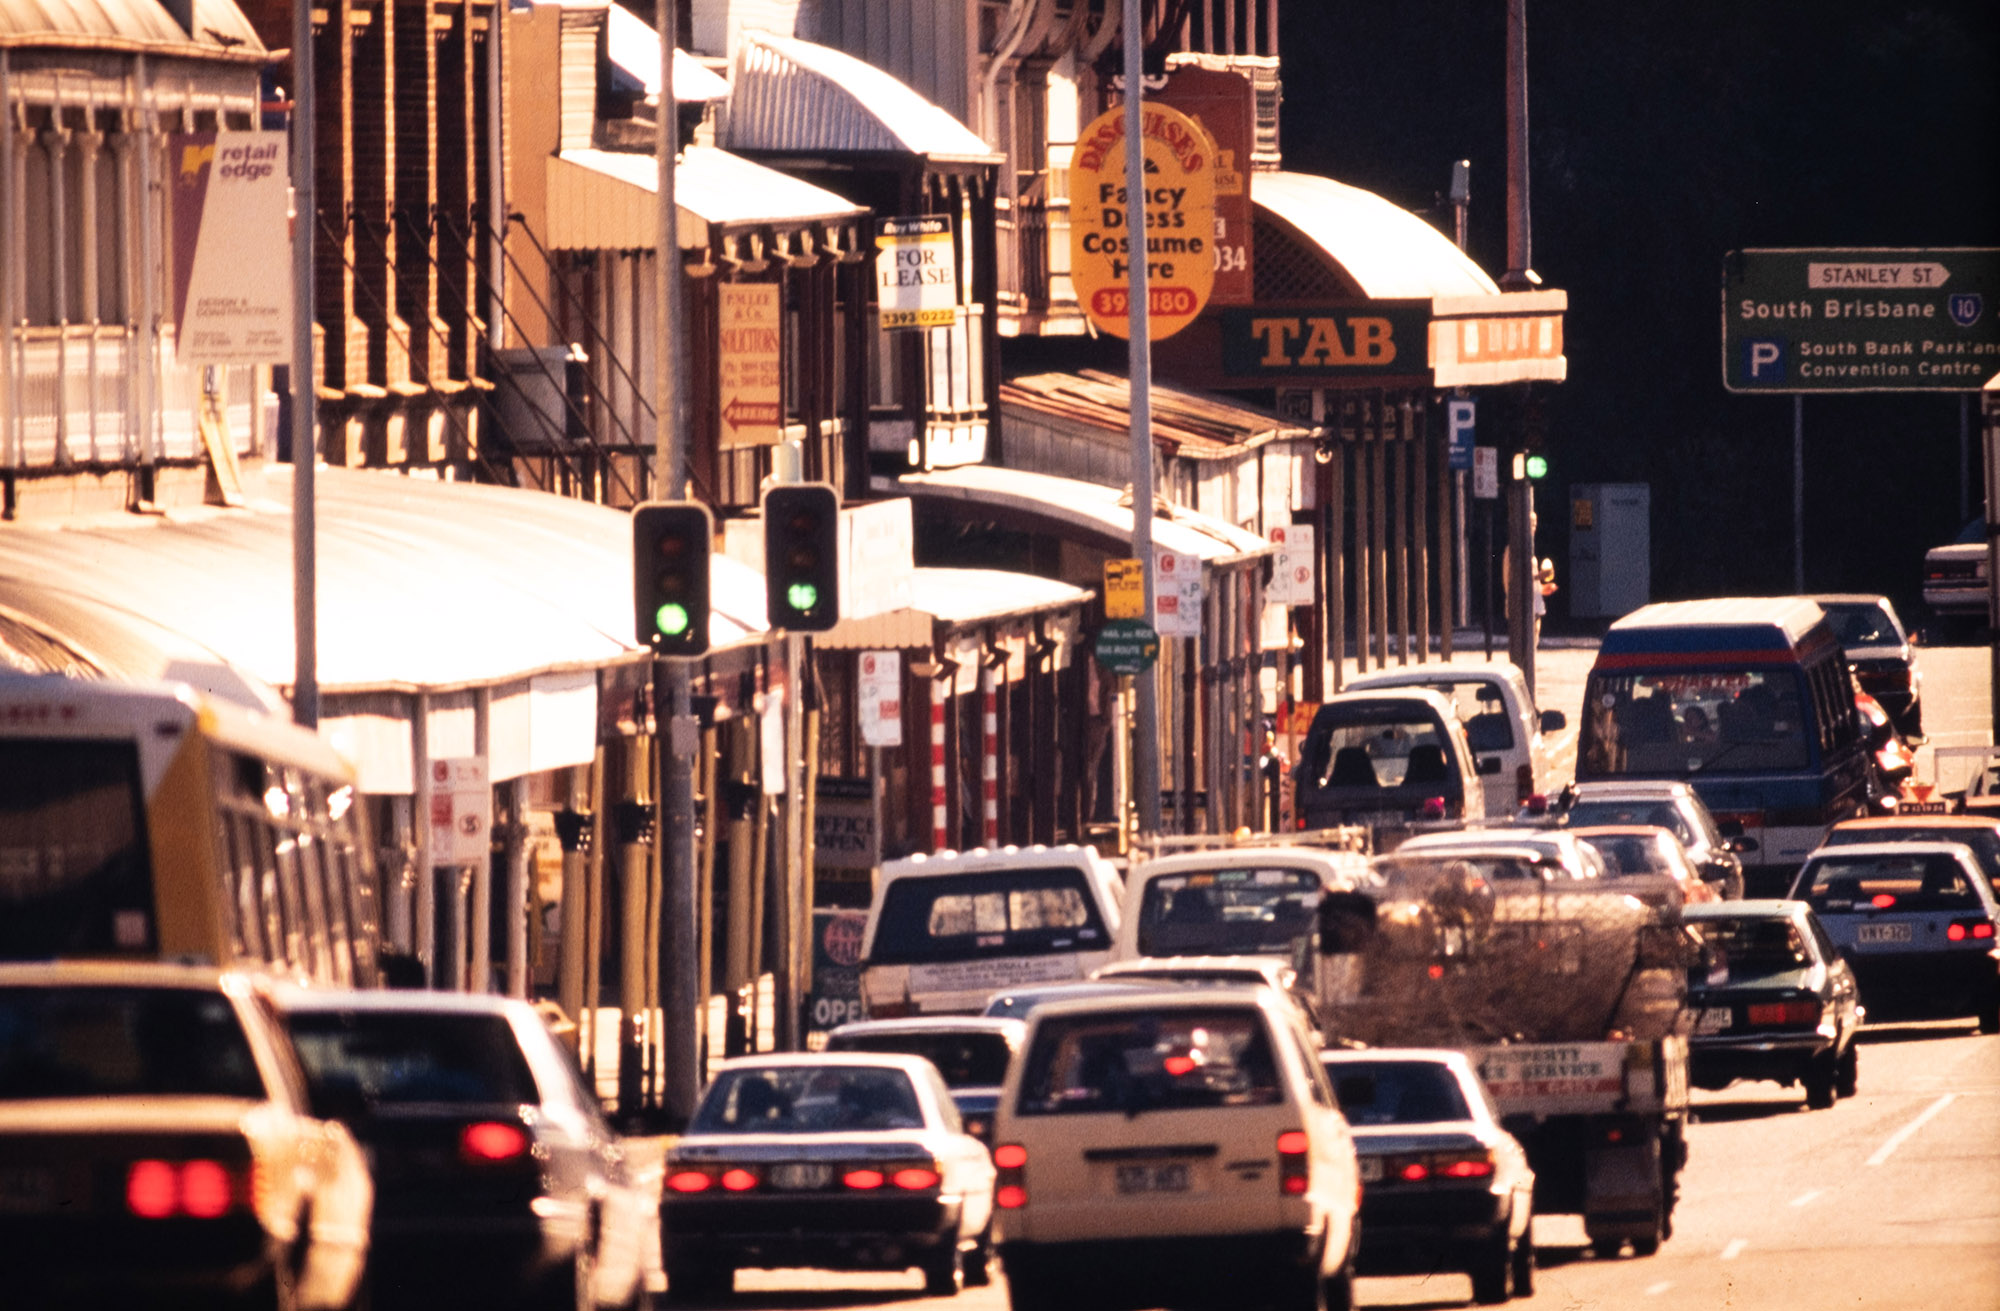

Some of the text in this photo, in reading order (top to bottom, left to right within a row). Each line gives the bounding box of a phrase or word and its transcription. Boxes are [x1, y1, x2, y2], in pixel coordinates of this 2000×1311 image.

[221, 144, 278, 161] retail
[220, 161, 273, 181] edge
[909, 220, 943, 233] White
[1103, 208, 1185, 228] Dess
[1083, 233, 1203, 254] Cosume
[896, 249, 936, 267] FOR
[883, 267, 952, 288] LEASE
[1113, 258, 1174, 279] Hre
[1823, 268, 1933, 284] STANLEY ST
[1741, 299, 1936, 318] South Brisbane
[1958, 300, 1975, 318] 10
[1252, 317, 1397, 367] TAB
[1801, 341, 1857, 356] South
[1865, 341, 1913, 356] Bank
[1752, 343, 1780, 377] P
[1801, 361, 1982, 377] Convention Centre
[1449, 401, 1475, 443] P
[1114, 644, 1140, 655] ROUTE
[815, 816, 873, 834] FFICE
[815, 999, 866, 1023] OPE
